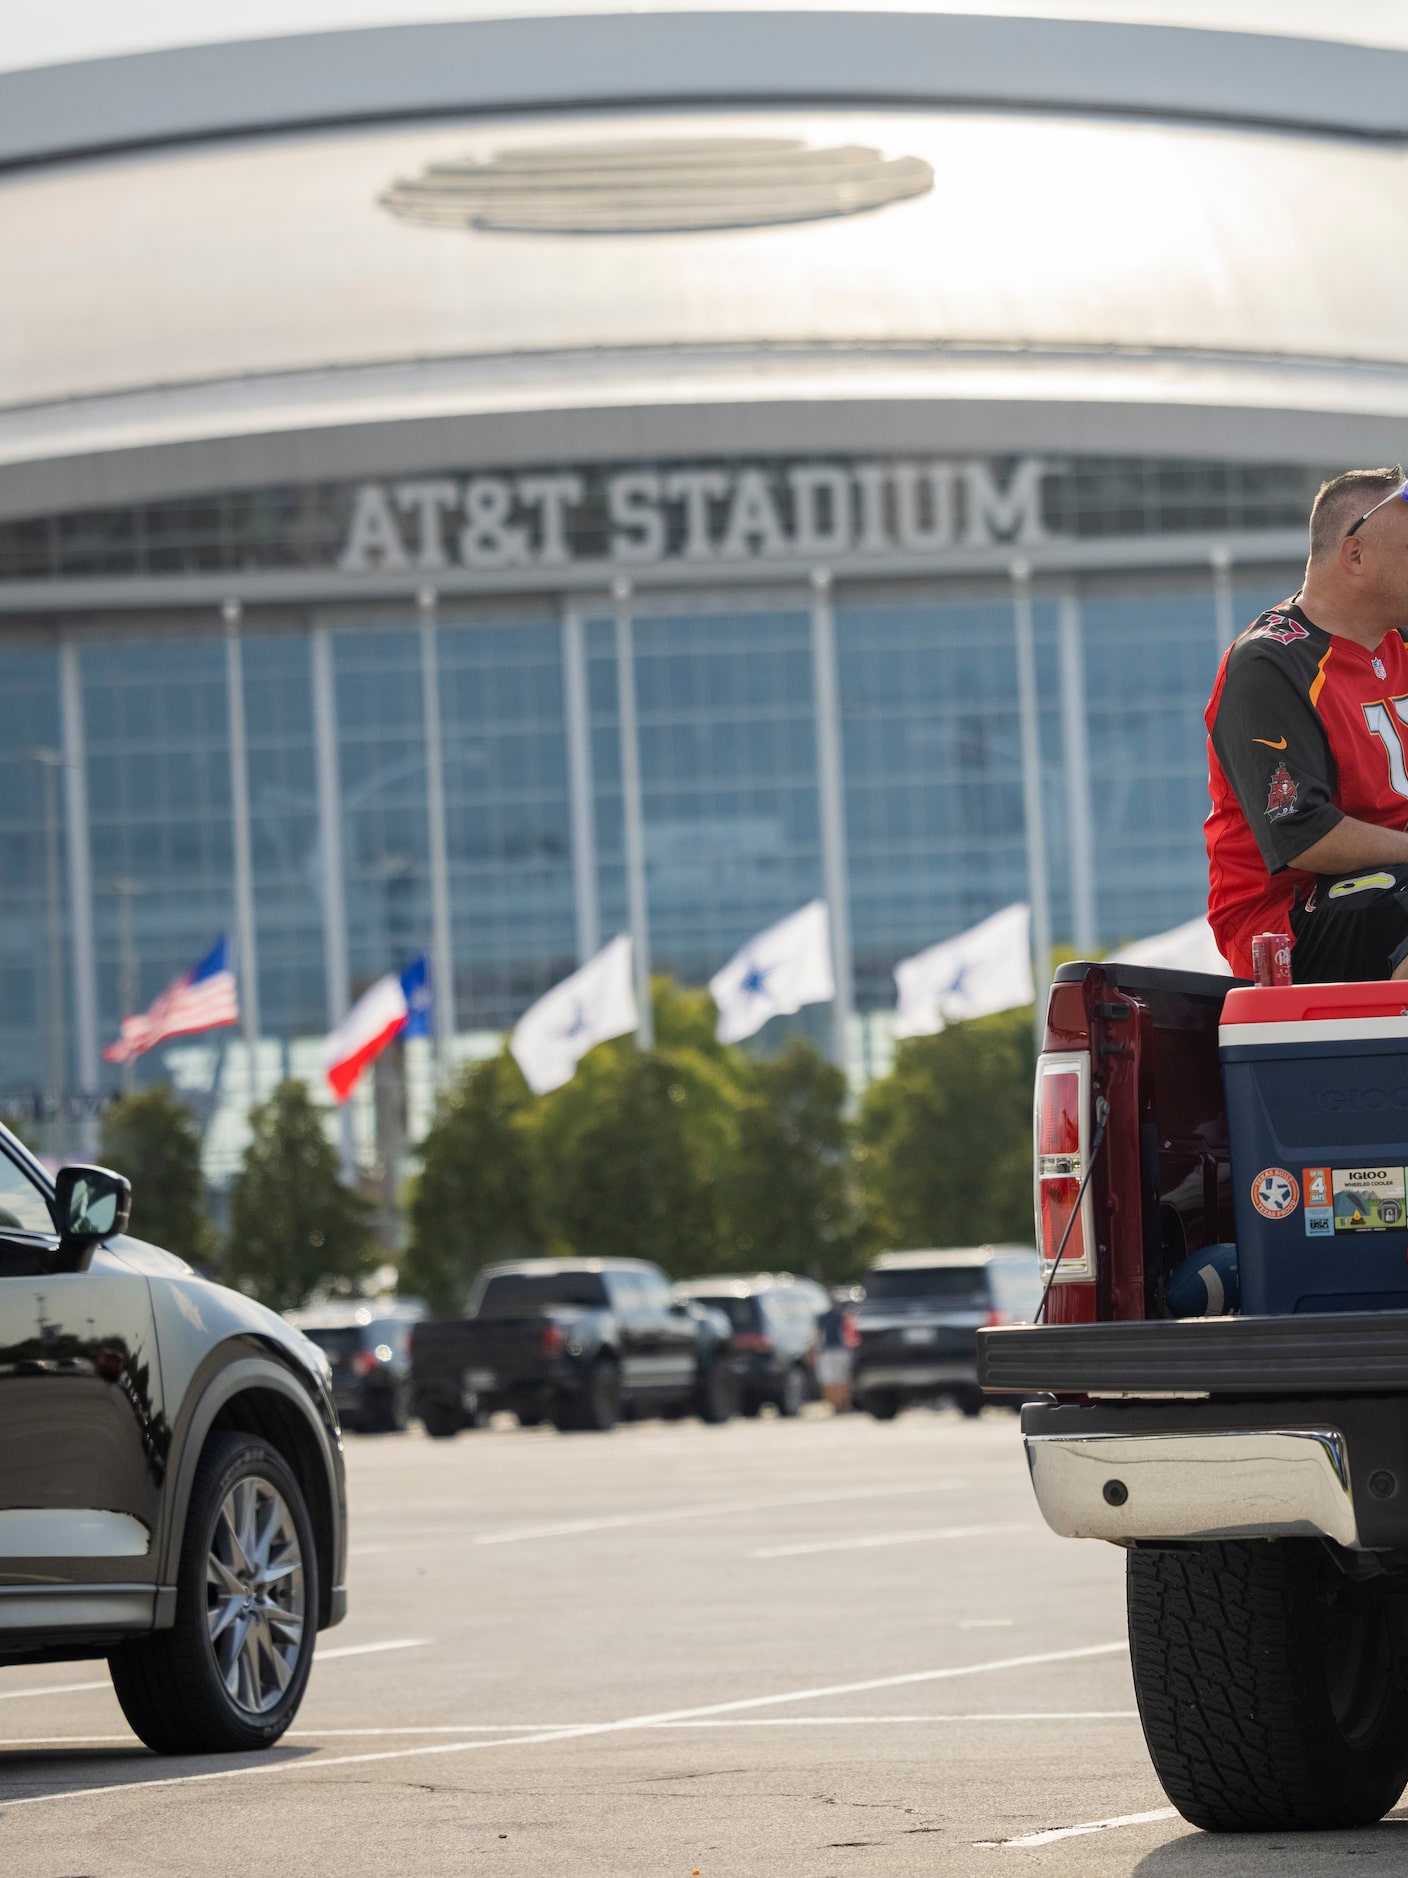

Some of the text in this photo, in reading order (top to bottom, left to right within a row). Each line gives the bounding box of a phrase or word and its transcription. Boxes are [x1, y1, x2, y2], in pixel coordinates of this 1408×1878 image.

[338, 460, 1046, 570] AT&T STADIUM
[1349, 1171, 1387, 1180] IGLOO
[1311, 1177, 1325, 1193] 4
[1257, 1204, 1276, 1217] TEXAS
